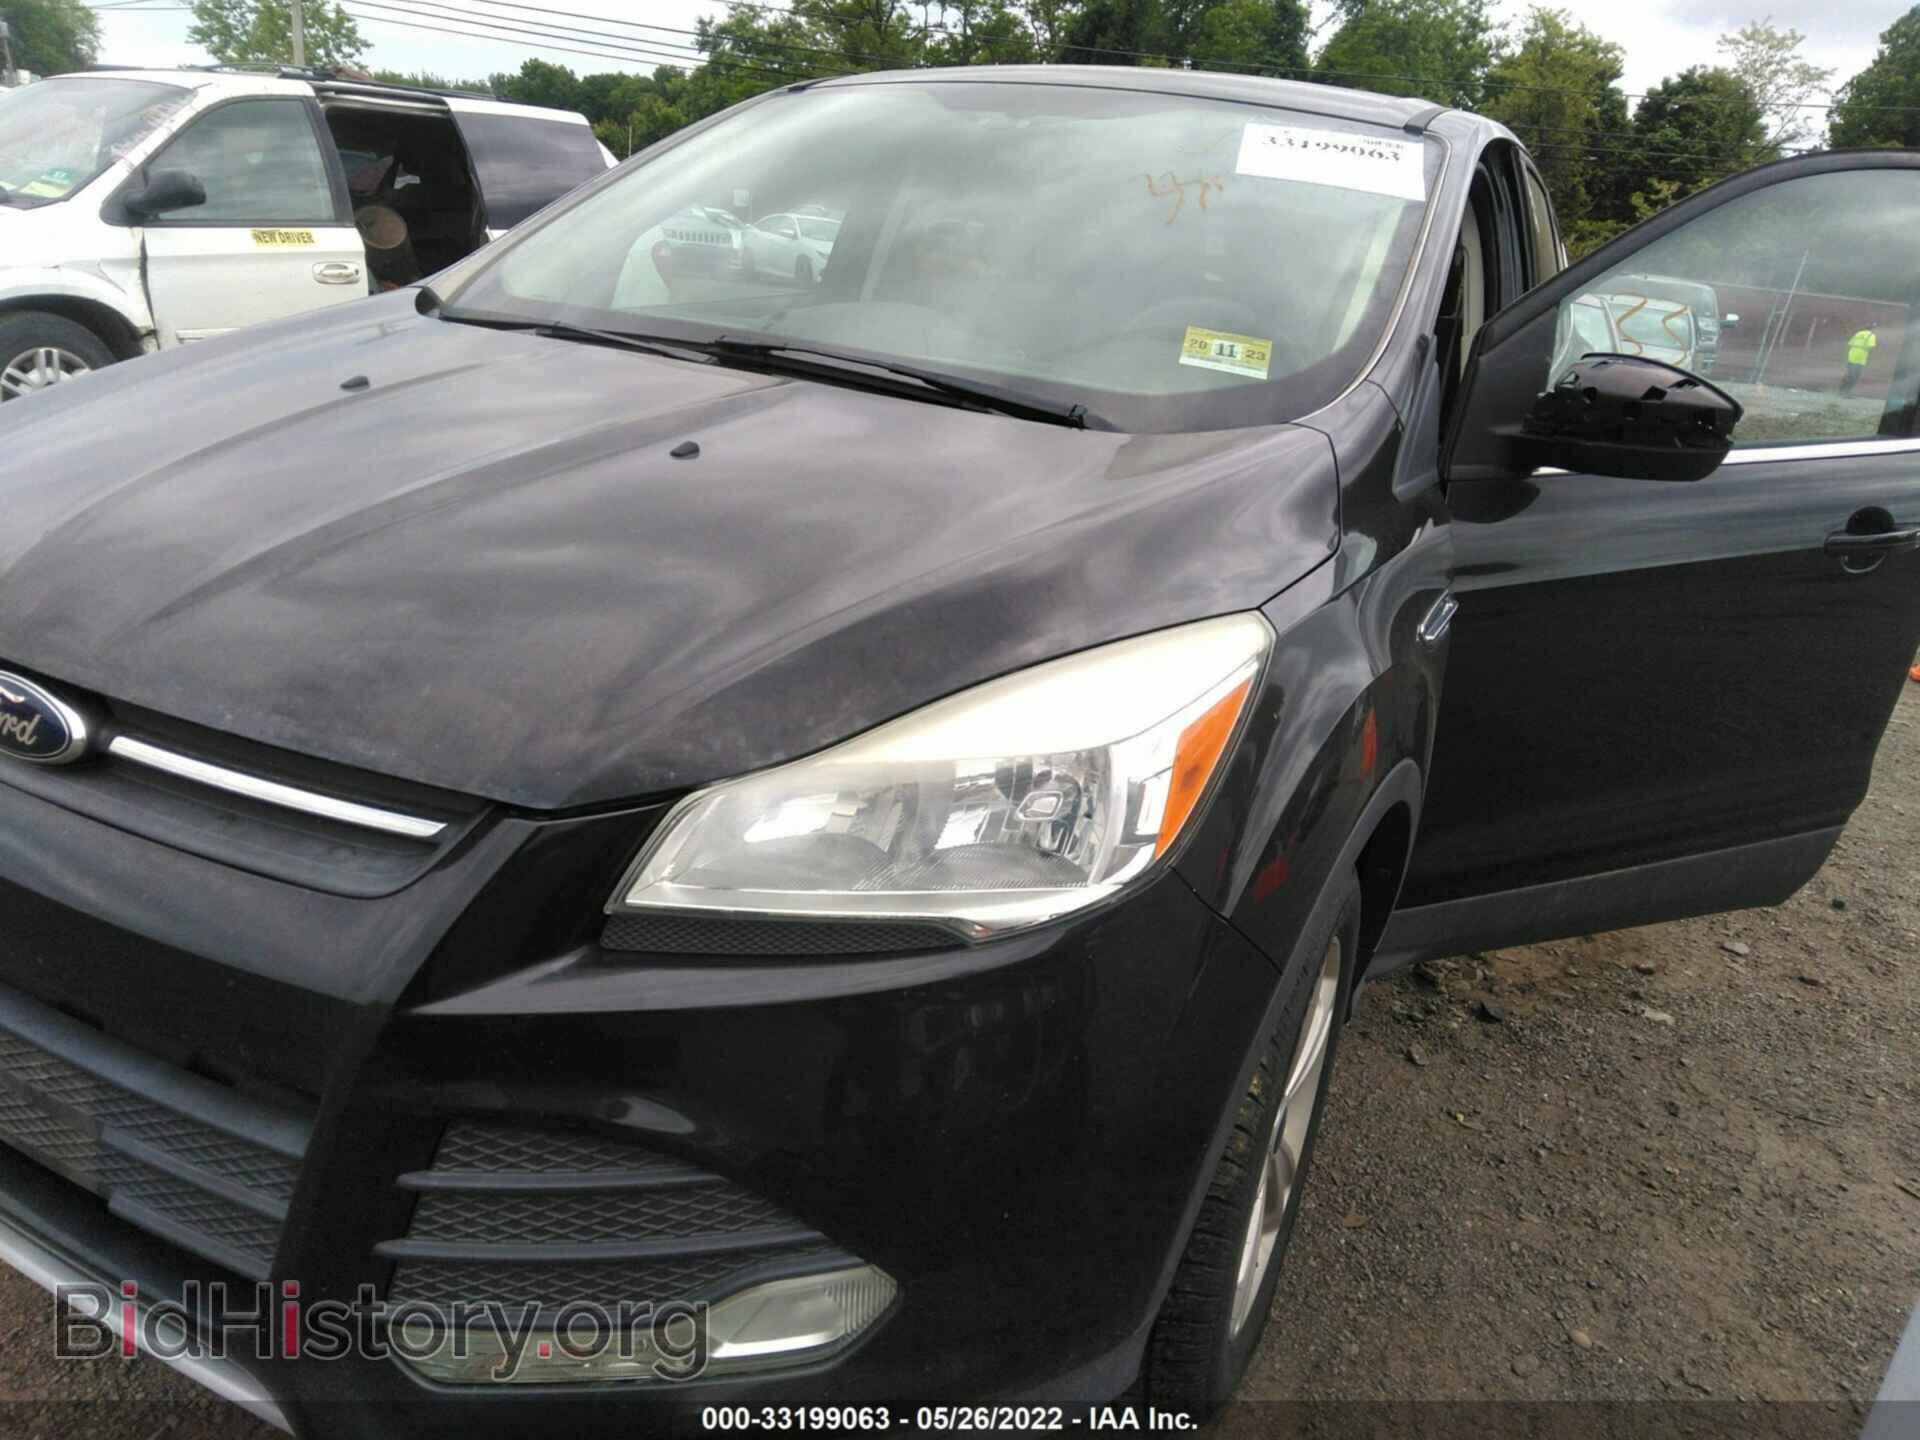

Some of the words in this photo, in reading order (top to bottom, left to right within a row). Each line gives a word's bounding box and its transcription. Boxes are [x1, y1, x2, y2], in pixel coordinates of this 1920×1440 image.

[253, 230, 278, 244] NEW
[279, 231, 316, 244] DRIVER
[1189, 338, 1208, 350] 20
[1216, 342, 1238, 358] 11
[1245, 349, 1267, 361] 23
